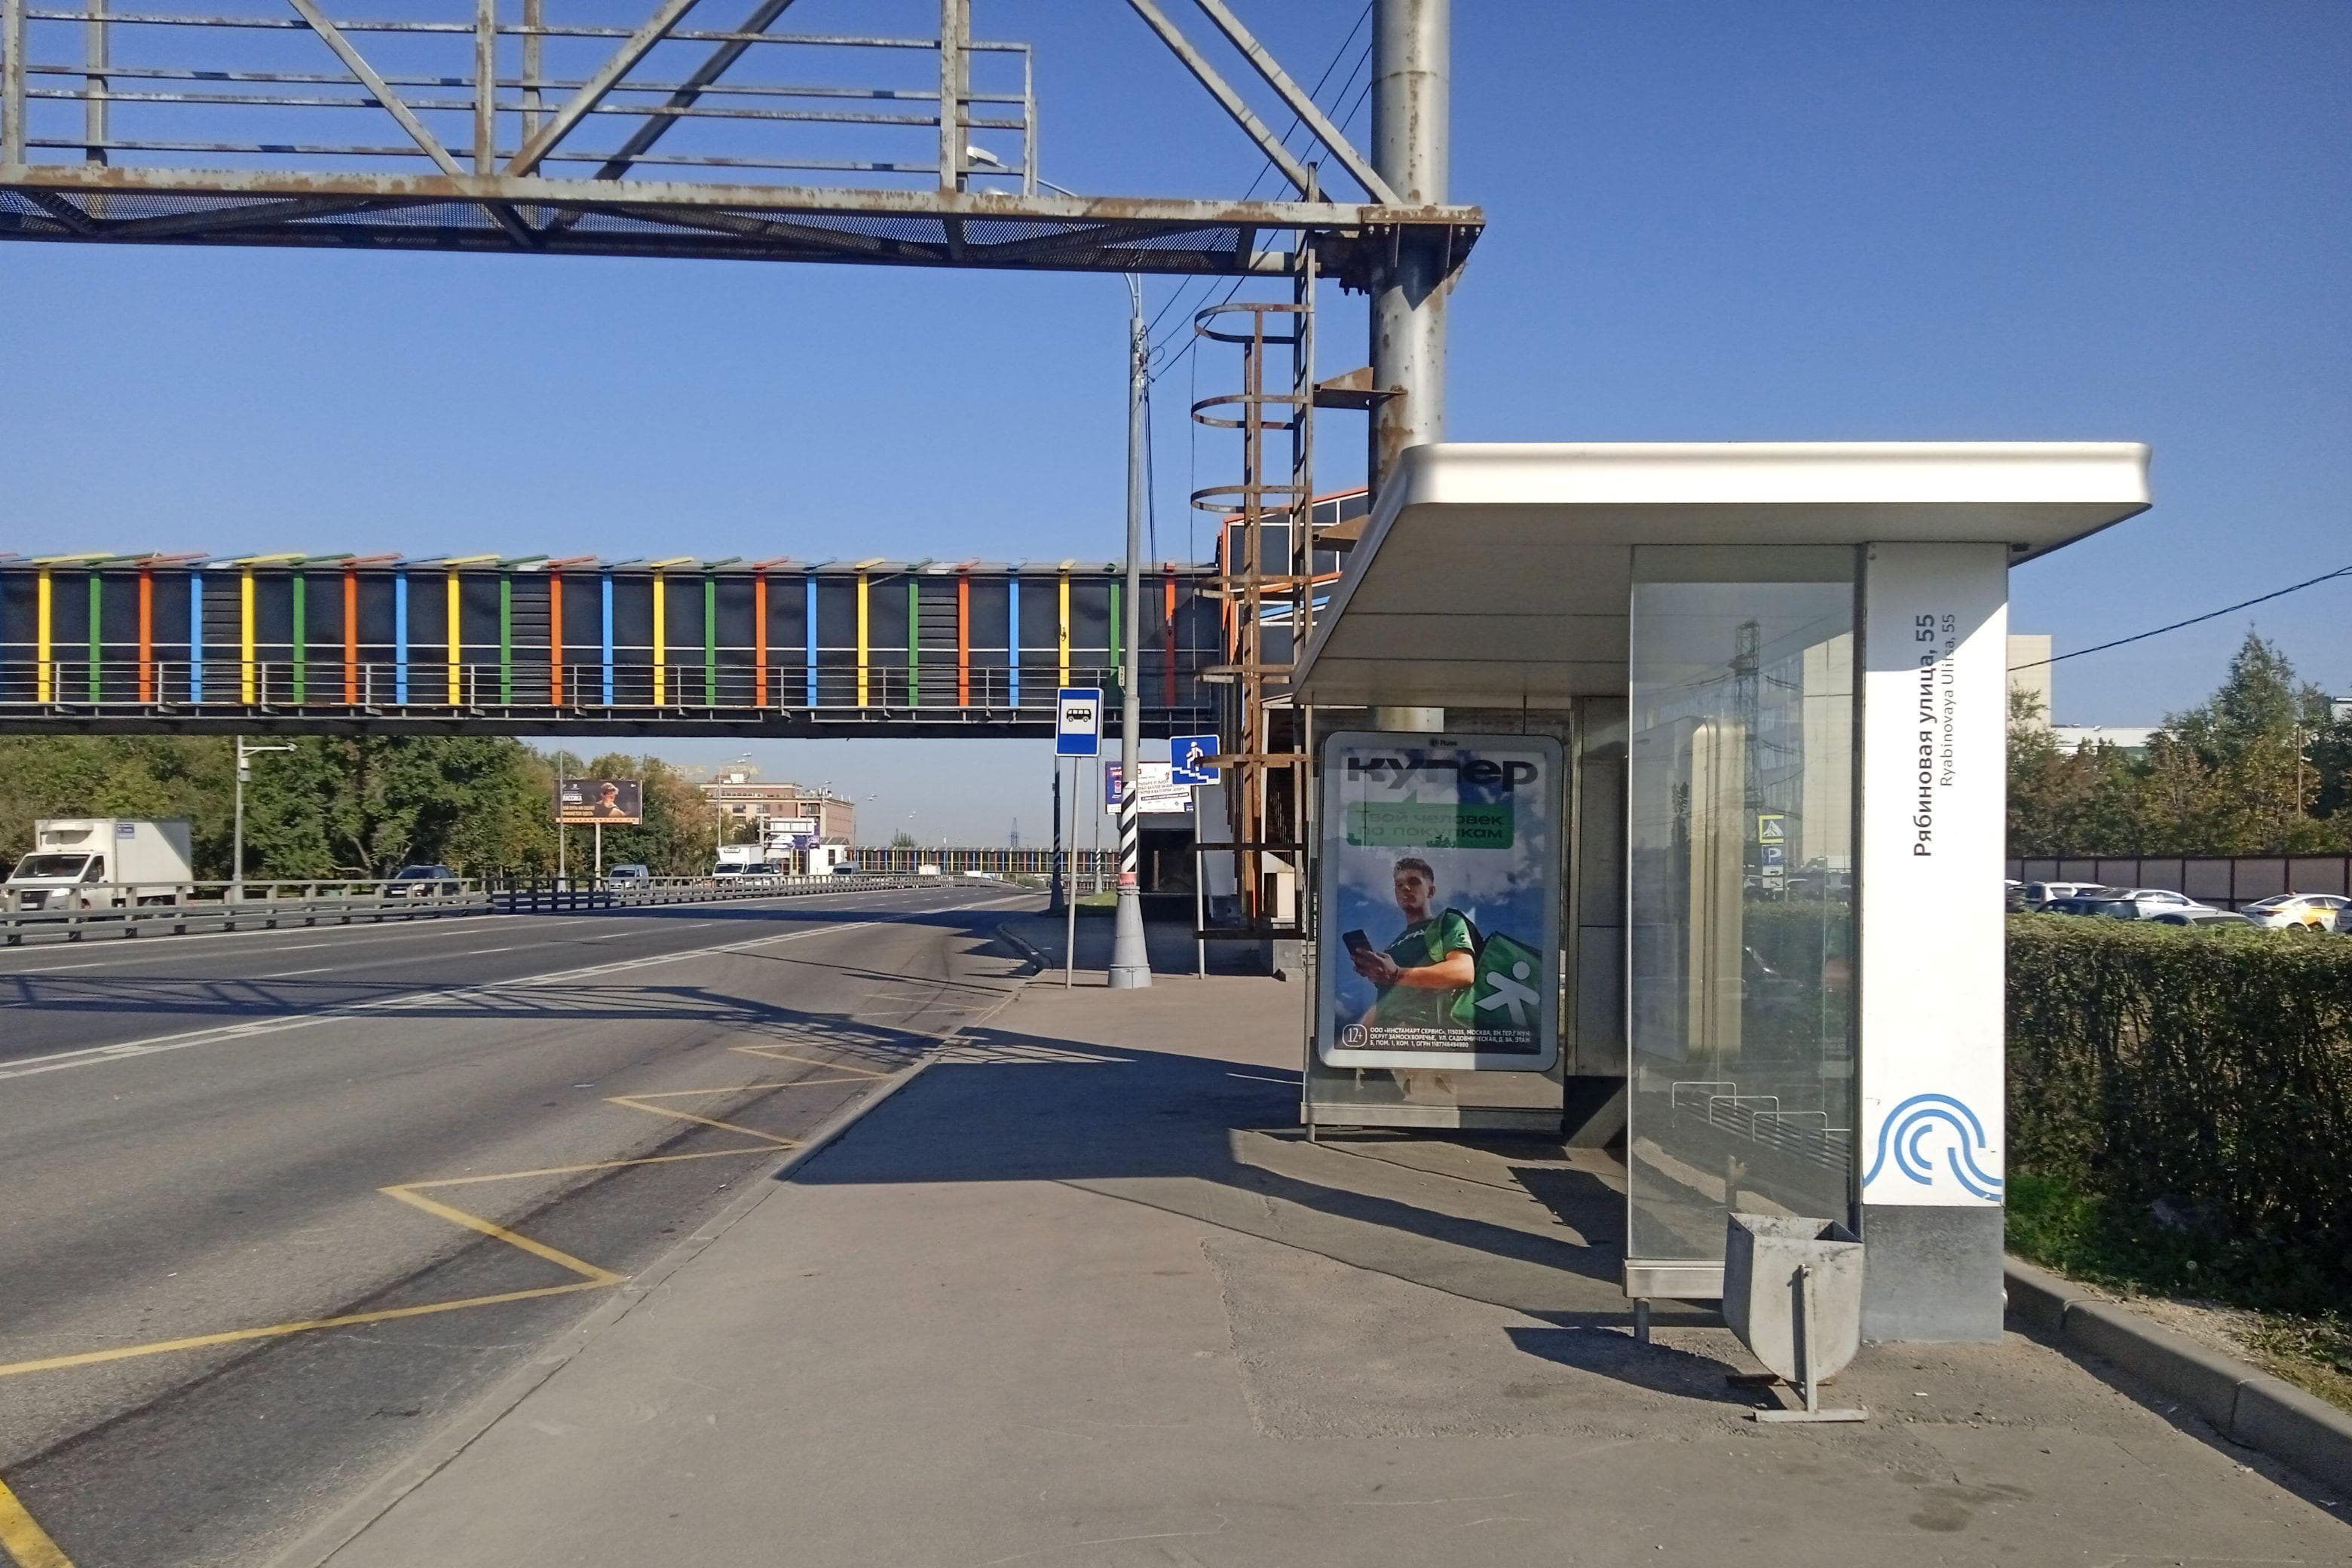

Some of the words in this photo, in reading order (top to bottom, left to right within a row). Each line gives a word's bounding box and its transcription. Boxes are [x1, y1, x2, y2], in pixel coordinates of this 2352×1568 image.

[1916, 614, 1934, 642] 55
[1941, 614, 1955, 632] 55
[1941, 637, 1956, 684] Ulitsa,
[1920, 650, 1937, 724] улица,
[1940, 690, 1956, 786] Ryabinovaya
[1347, 757, 1539, 792] купер
[1913, 730, 1933, 856] Рябиновая
[1358, 828, 1384, 836] по
[1394, 828, 1502, 838] покупкам
[1360, 811, 1407, 822] Твой
[1414, 813, 1504, 825] человек
[1347, 1027, 1363, 1043] 12+
